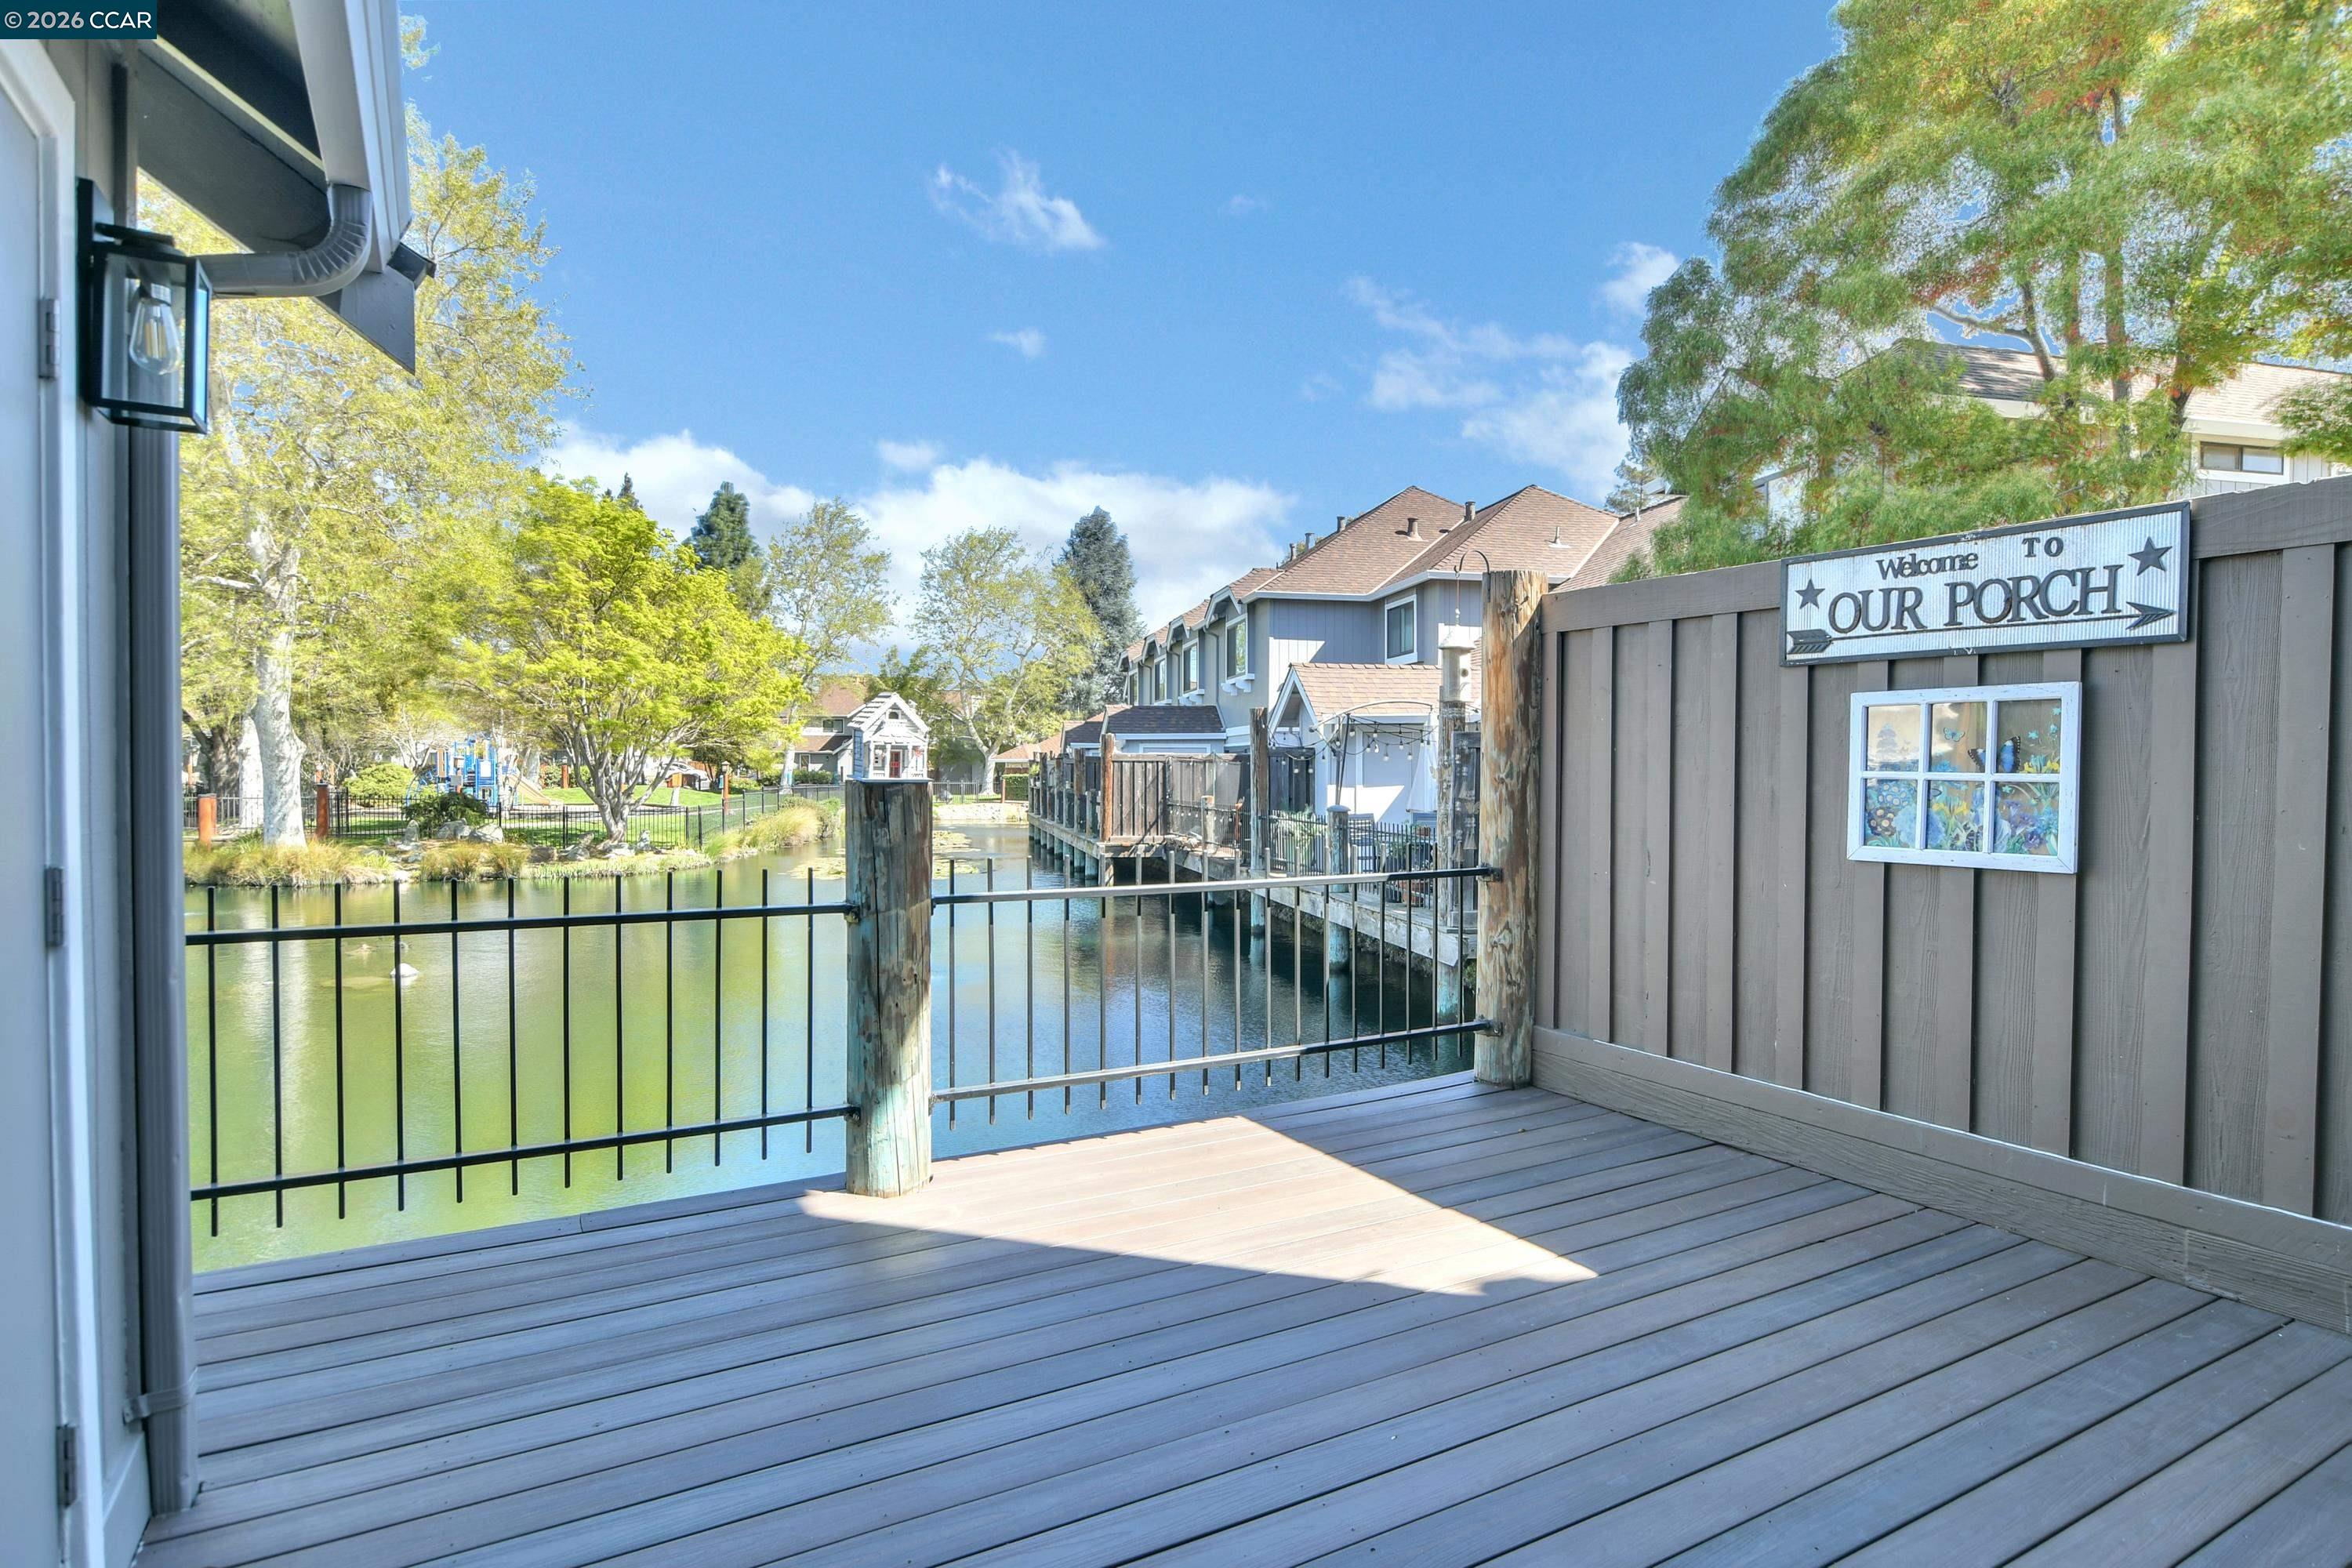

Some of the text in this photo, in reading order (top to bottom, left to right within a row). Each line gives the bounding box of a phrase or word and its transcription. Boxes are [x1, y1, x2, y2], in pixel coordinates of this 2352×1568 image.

[1876, 536, 2064, 580] Welcome TO
[1828, 564, 2123, 634] OUR PORCH
